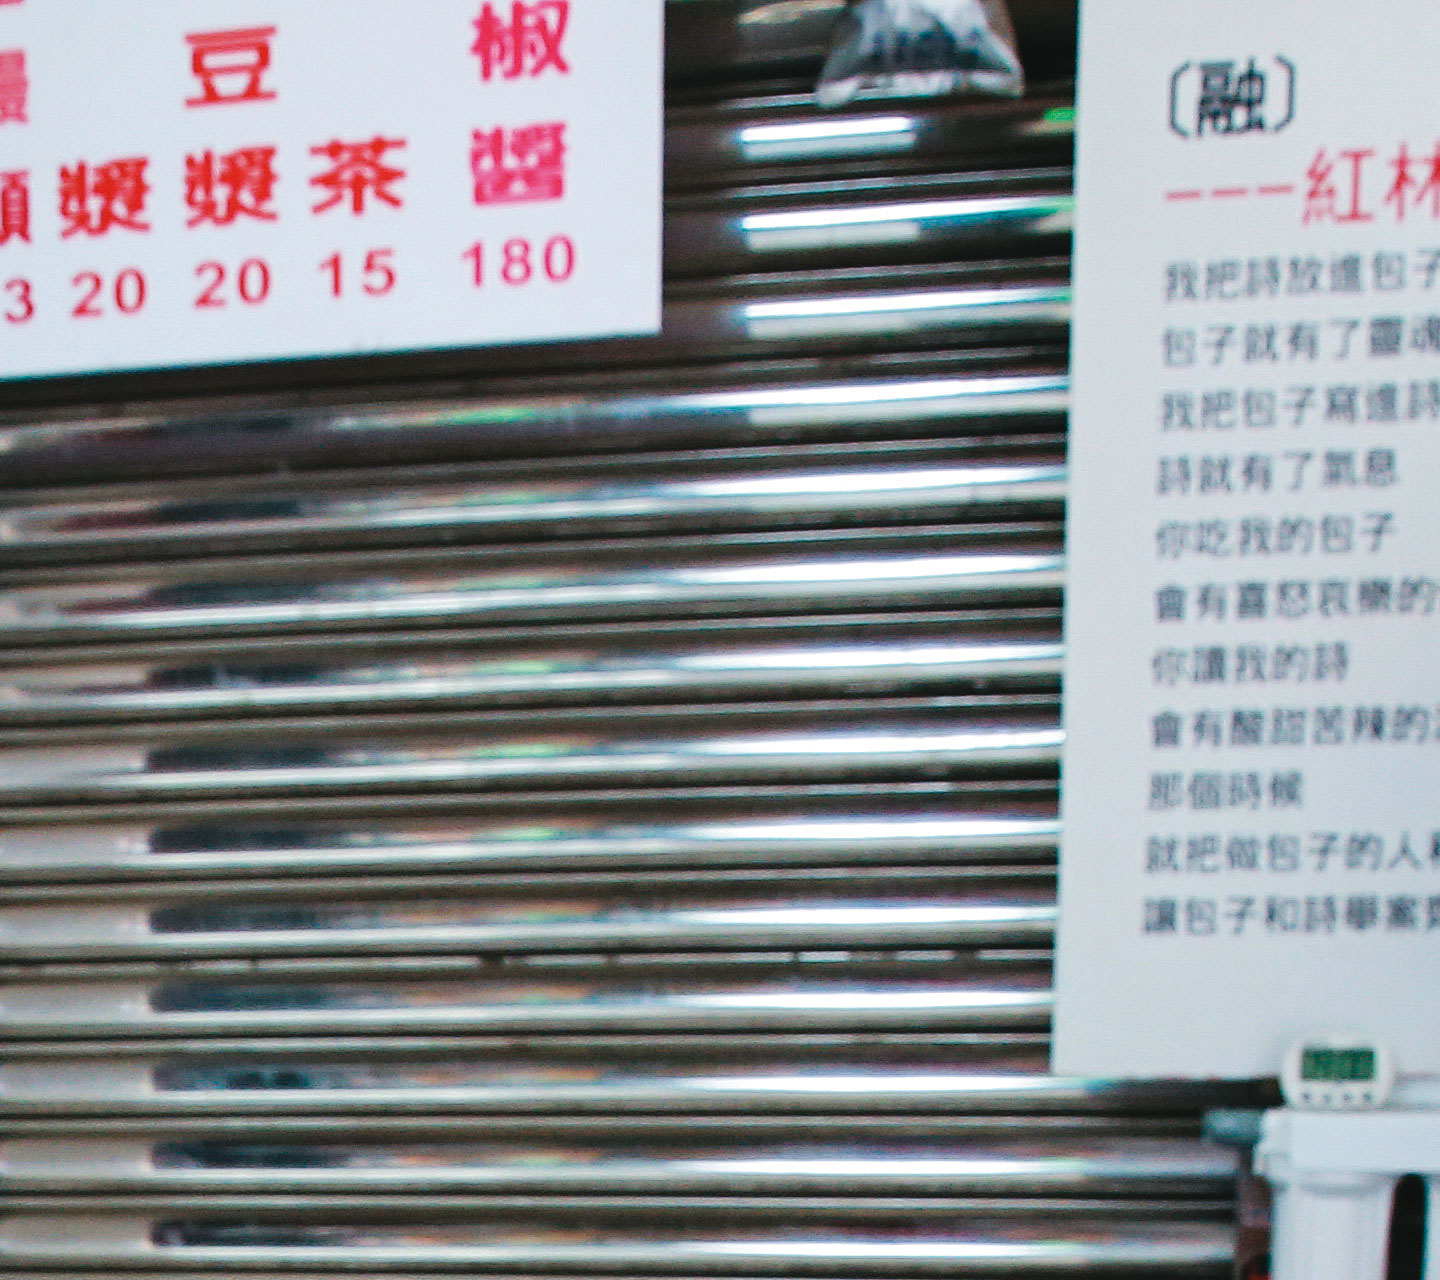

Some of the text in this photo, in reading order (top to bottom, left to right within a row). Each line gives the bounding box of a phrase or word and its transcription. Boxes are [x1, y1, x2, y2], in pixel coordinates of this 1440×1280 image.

[183, 25, 280, 309] 豆漿 20
[309, 134, 407, 298] 茶 15
[462, 235, 575, 288] 180
[71, 269, 147, 318] 20
[1154, 511, 1397, 559] 你吃我的包子
